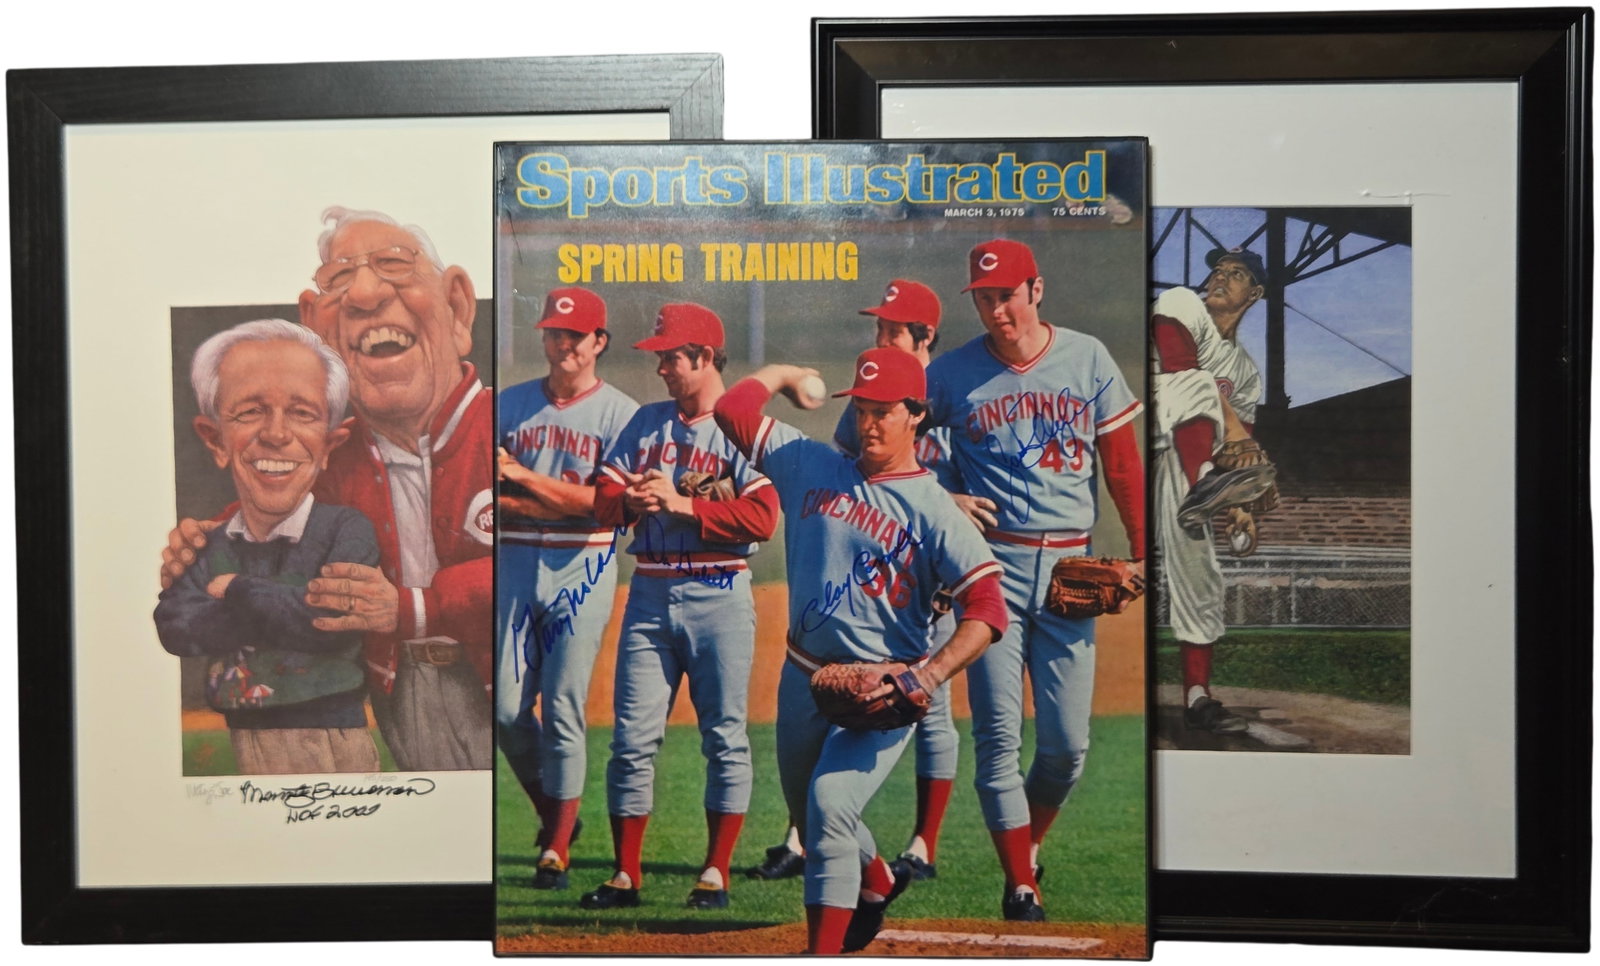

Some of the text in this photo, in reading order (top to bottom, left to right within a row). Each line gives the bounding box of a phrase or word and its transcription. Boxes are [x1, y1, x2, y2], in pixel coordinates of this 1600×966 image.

[517, 149, 1106, 219] Sports Illustrated
[944, 207, 1025, 218] MARCH 3, 1975
[1052, 206, 1107, 216] 75 CENTS
[558, 241, 859, 284] SPRING TRAINING
[979, 252, 999, 271] C
[556, 297, 575, 314] C
[860, 361, 880, 381] C
[966, 391, 1090, 444] CINCINNATI
[1038, 437, 1085, 473] 43
